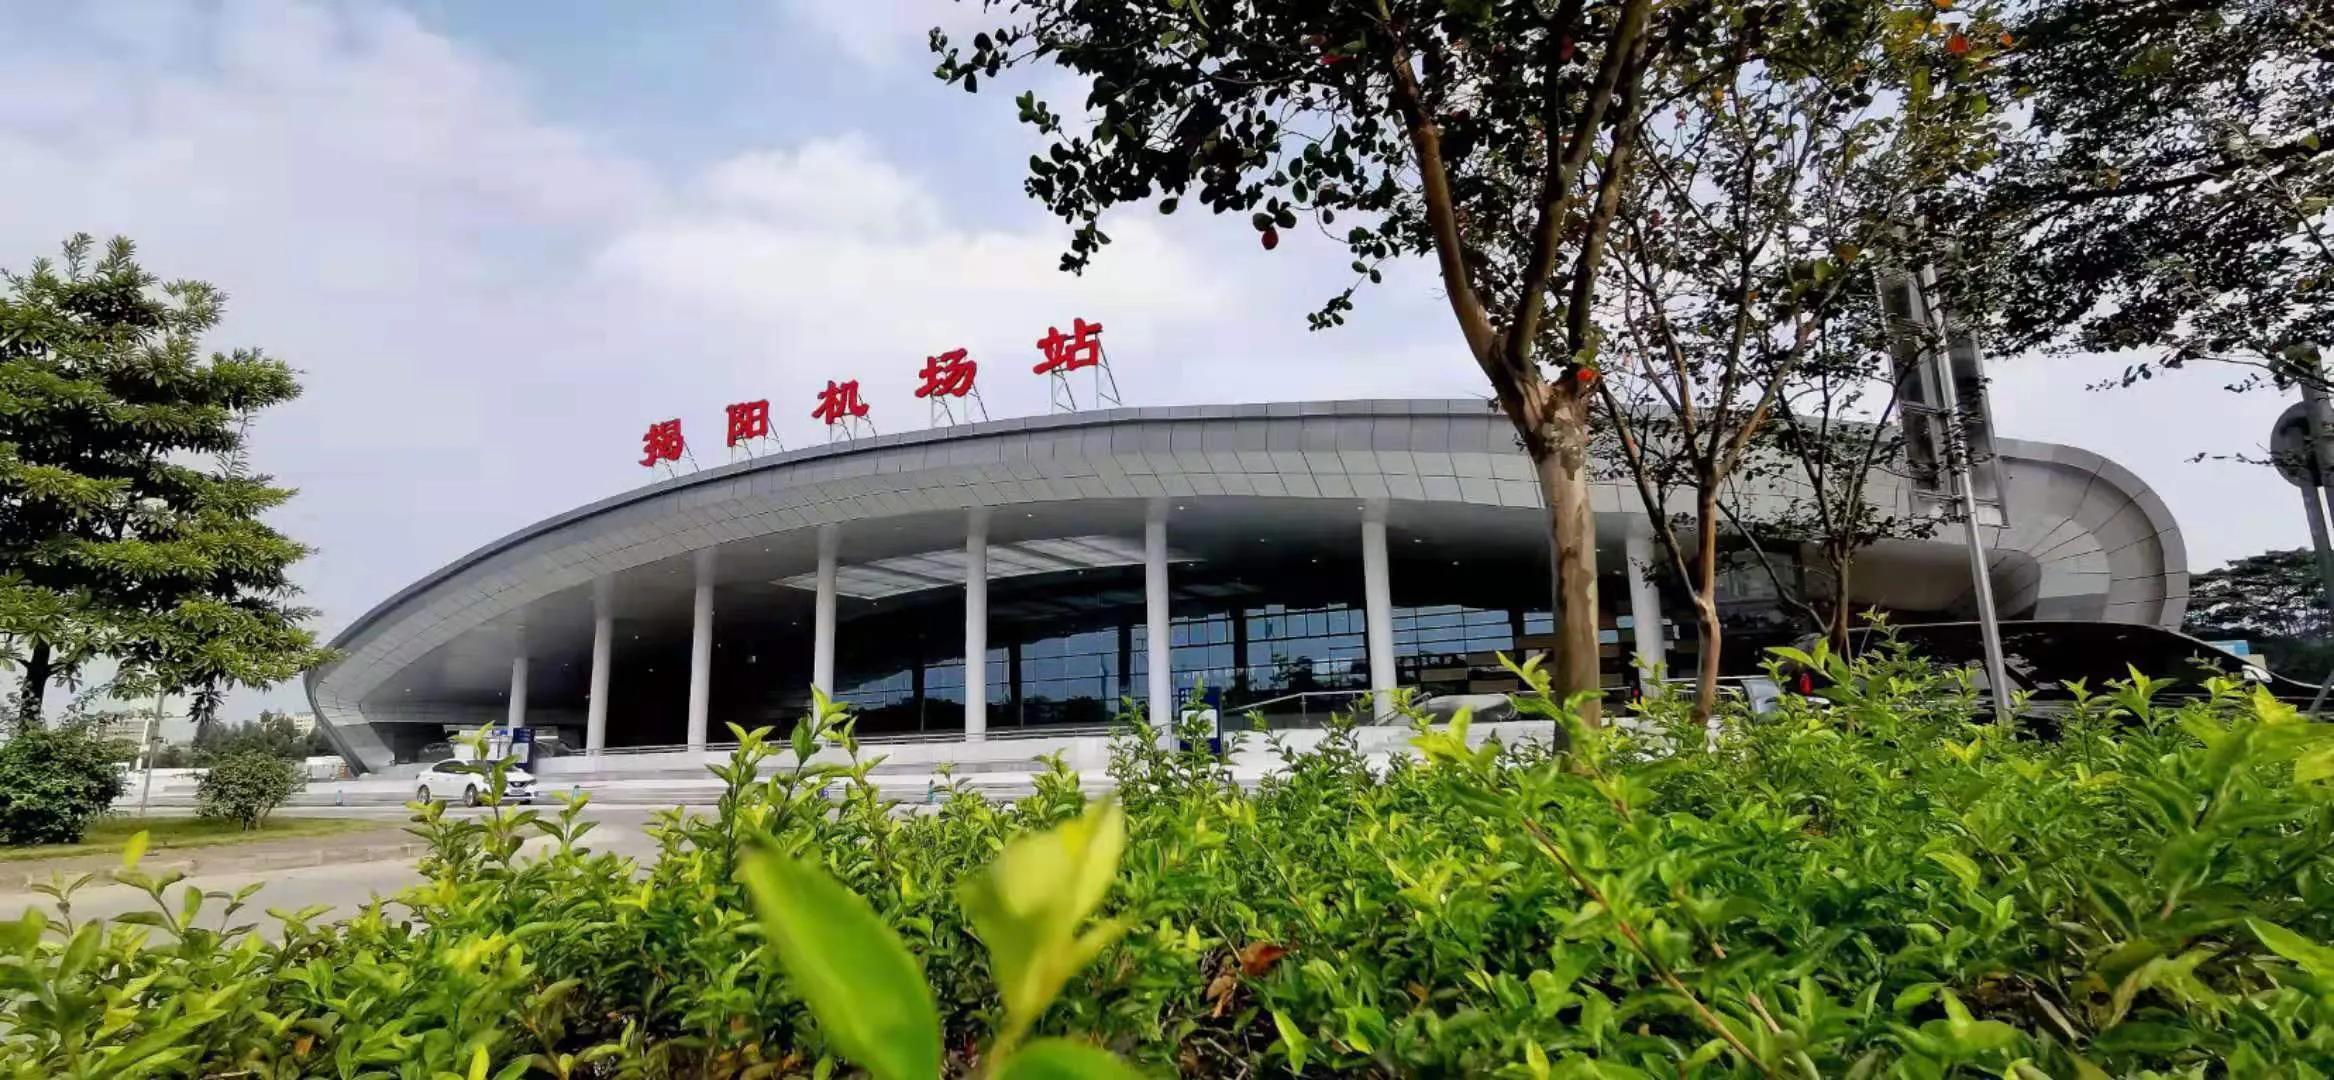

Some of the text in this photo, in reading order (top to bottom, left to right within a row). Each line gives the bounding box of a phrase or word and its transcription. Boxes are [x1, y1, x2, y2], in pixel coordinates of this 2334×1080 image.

[639, 318, 1103, 467] 揭阳机场站
